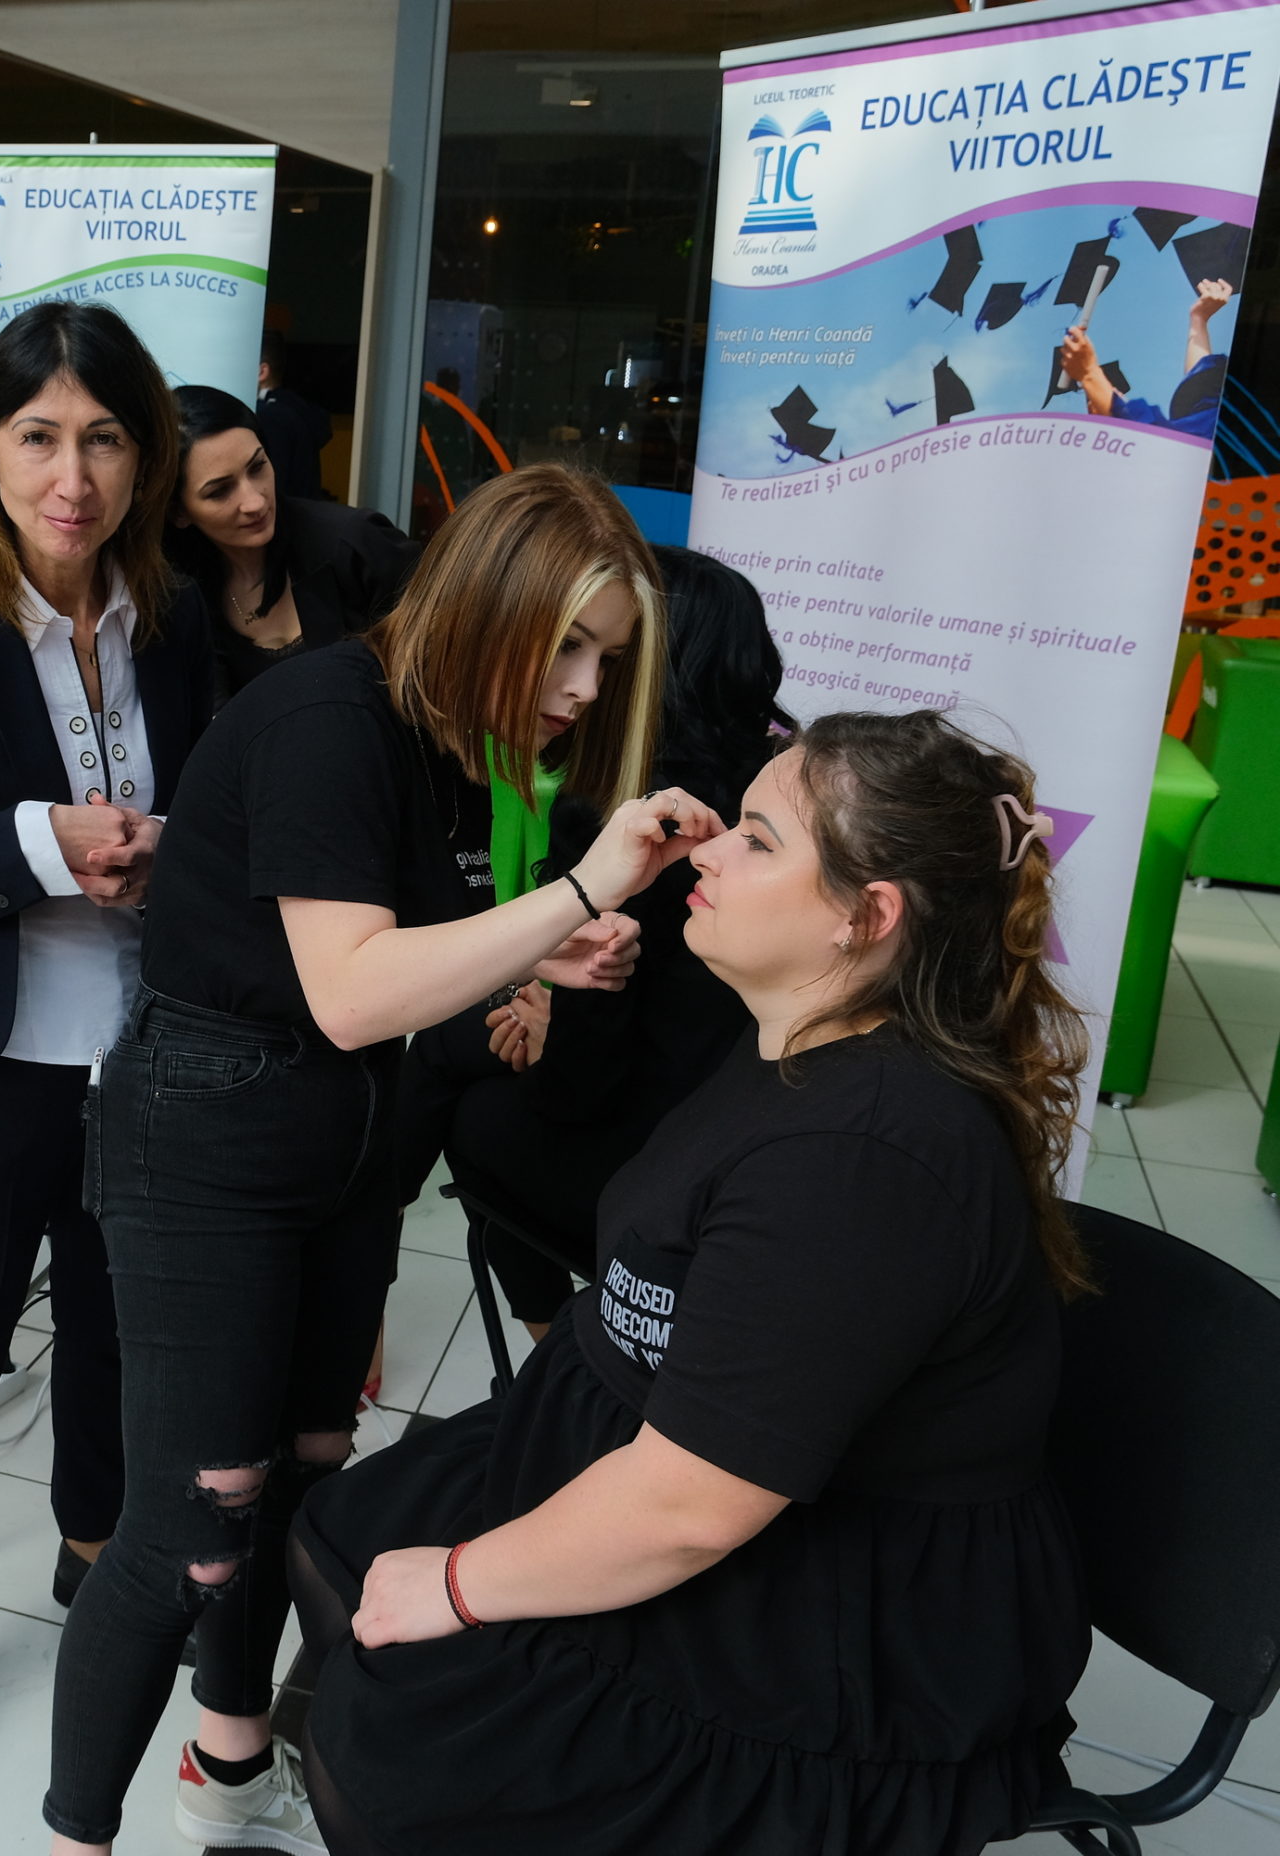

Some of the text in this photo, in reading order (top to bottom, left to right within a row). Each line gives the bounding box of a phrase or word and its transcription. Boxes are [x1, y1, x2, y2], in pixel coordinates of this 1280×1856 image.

[753, 84, 836, 105] LICEUL TEORETIC
[949, 125, 1113, 172] VIITORUL
[86, 220, 187, 241] VIITORUL
[94, 271, 145, 295] ACCES
[150, 271, 170, 287] LA
[175, 271, 239, 298] SUCCES
[751, 265, 789, 277] ORADEA
[768, 326, 810, 342] Henri
[759, 350, 810, 368] pentru
[721, 483, 738, 501] Te
[742, 473, 820, 502] realizezi
[848, 464, 869, 482] cu
[875, 459, 886, 473] o
[890, 431, 971, 473] profesie
[978, 423, 1055, 447] alături
[1059, 426, 1087, 448] de
[1091, 430, 1136, 457] Bac
[774, 555, 811, 574] prin
[817, 560, 884, 582] calitate
[782, 631, 794, 643] a
[804, 597, 863, 617] pentru
[868, 604, 934, 627] valorile
[939, 614, 1003, 637] umane
[1029, 626, 1137, 656] spirituale
[608, 1260, 675, 1316] REFUSED
[600, 1287, 674, 1349] TO BECOM
